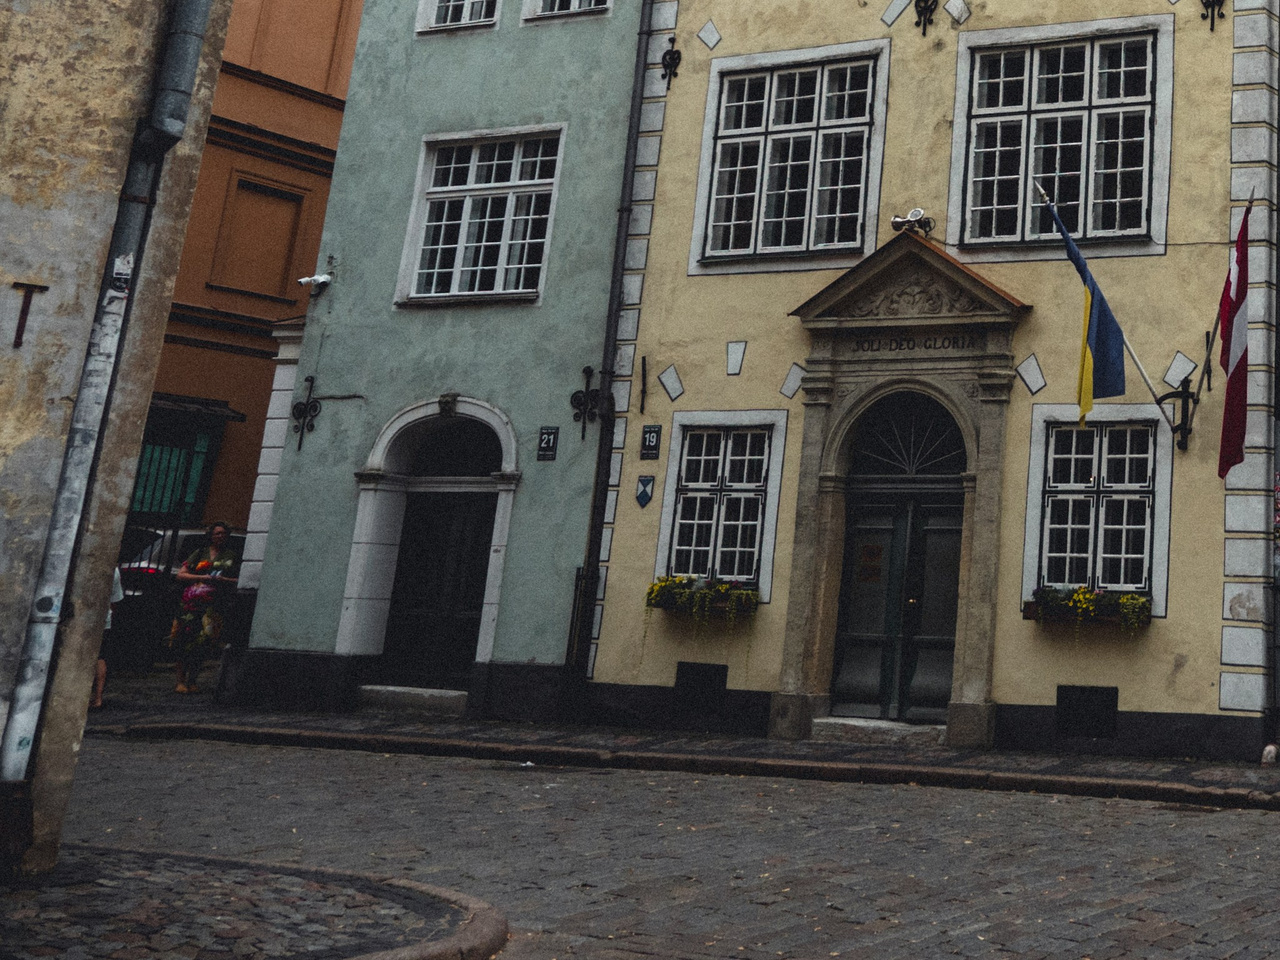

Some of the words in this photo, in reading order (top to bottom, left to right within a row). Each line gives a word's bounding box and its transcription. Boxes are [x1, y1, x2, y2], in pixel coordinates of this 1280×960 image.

[889, 337, 916, 352] DEO
[540, 434, 554, 447] 21
[644, 432, 657, 446] 19
